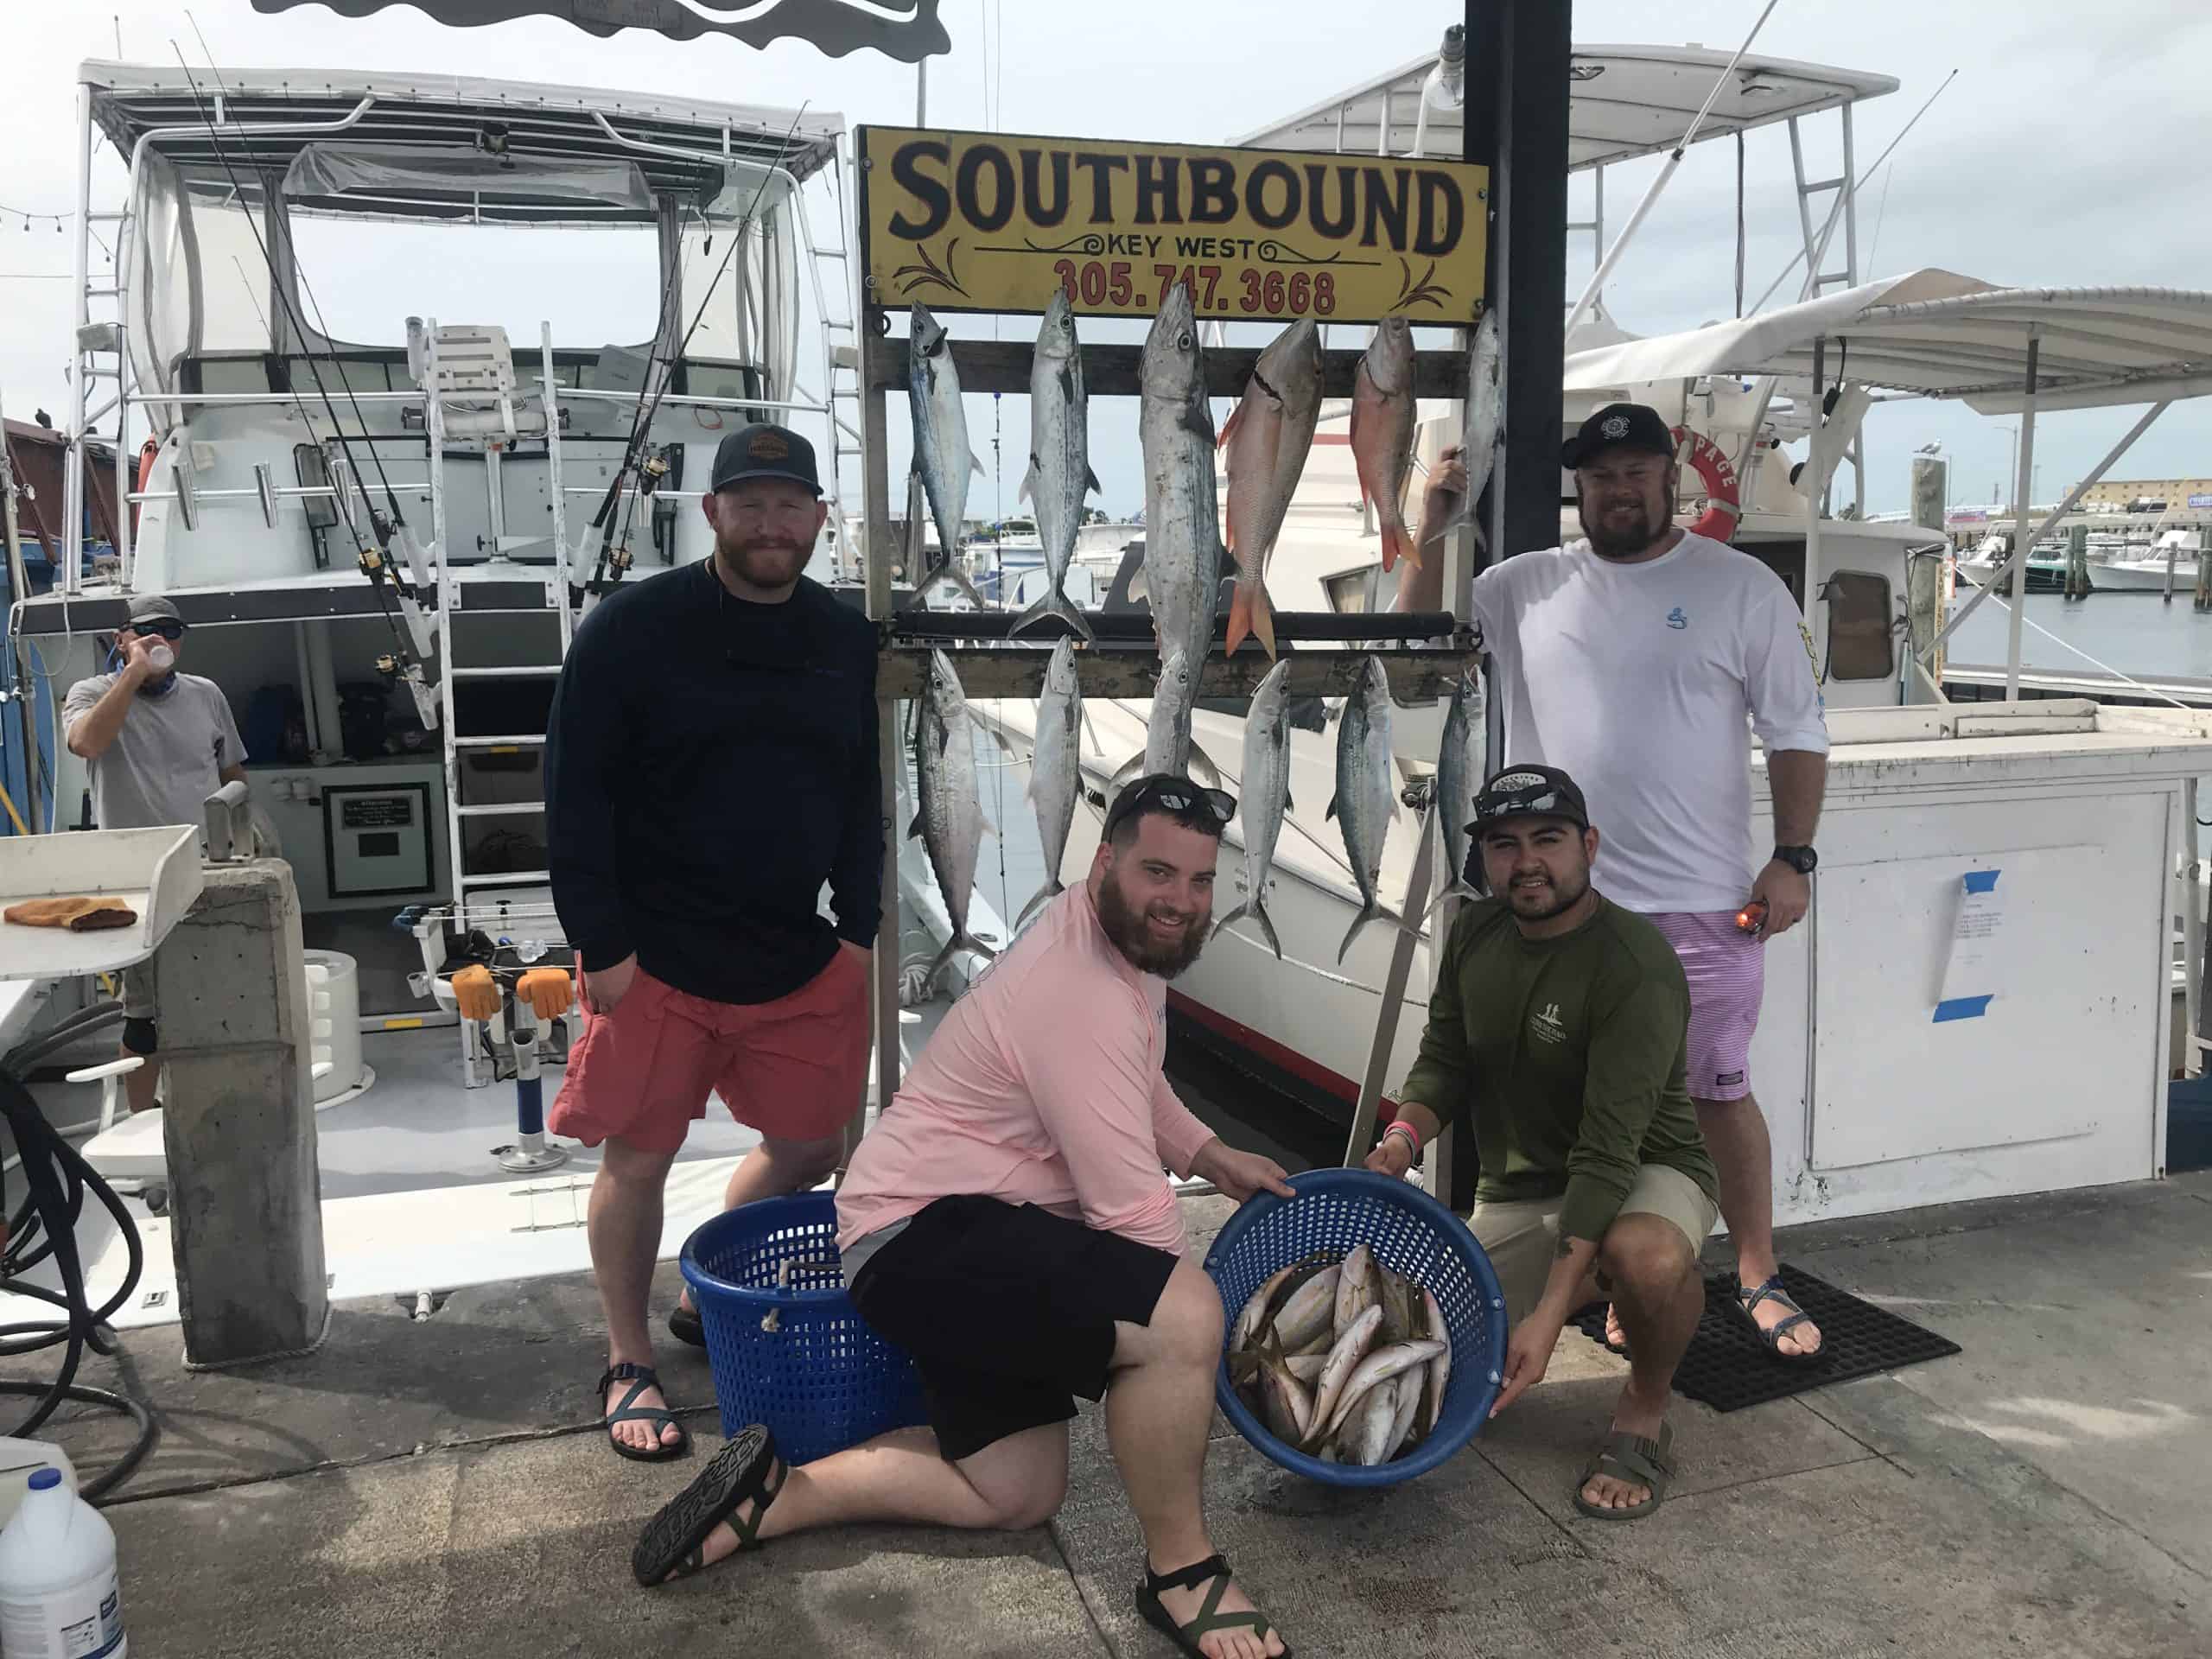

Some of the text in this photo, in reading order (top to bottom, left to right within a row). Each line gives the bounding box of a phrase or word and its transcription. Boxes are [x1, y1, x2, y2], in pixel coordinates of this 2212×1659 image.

[888, 140, 1464, 257] SOUTHBOUND
[1107, 233, 1255, 259] KEY WEST
